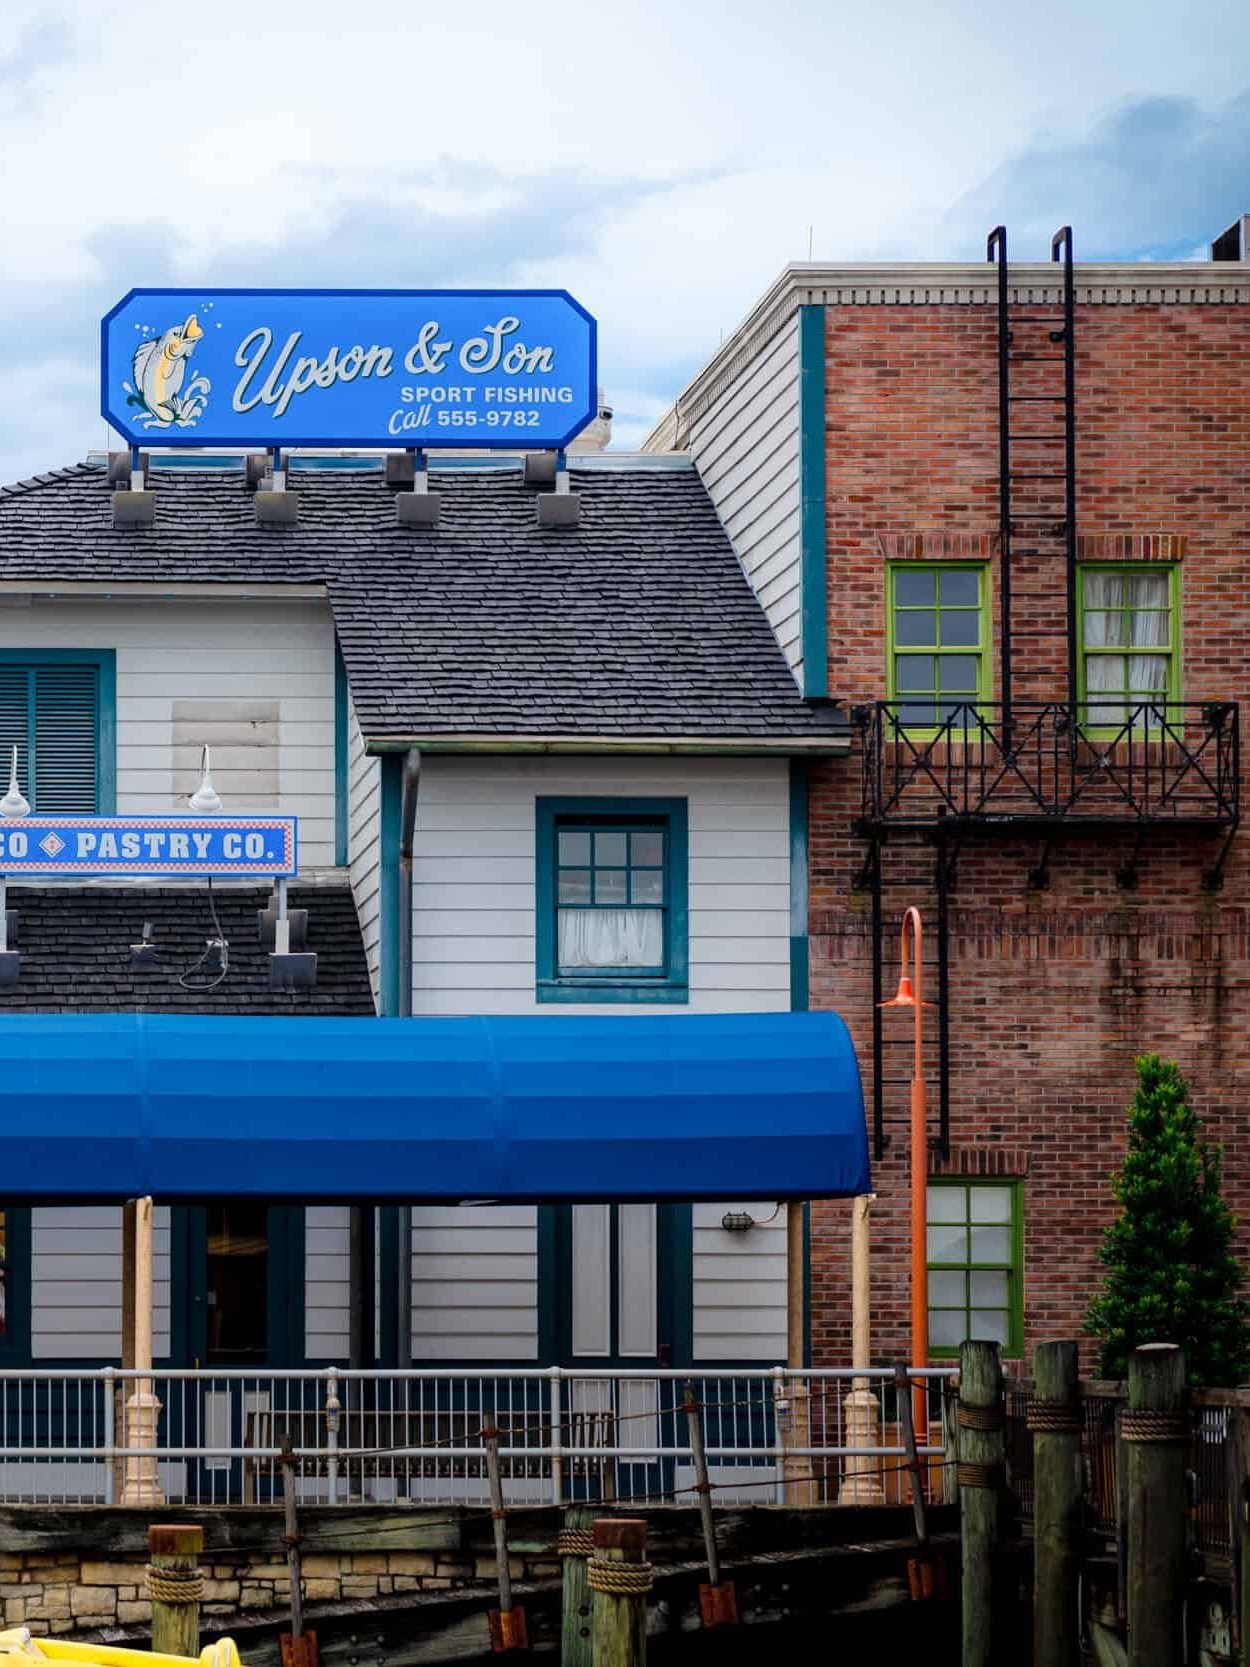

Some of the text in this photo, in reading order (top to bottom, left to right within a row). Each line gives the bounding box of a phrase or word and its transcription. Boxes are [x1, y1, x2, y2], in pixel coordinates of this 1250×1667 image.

[232, 316, 554, 417] Upson & Son
[400, 386, 573, 403] SPORT FISHING
[388, 404, 541, 434] Call 555-9782
[76, 832, 219, 859] PASTRY
[222, 832, 275, 859] CO.
